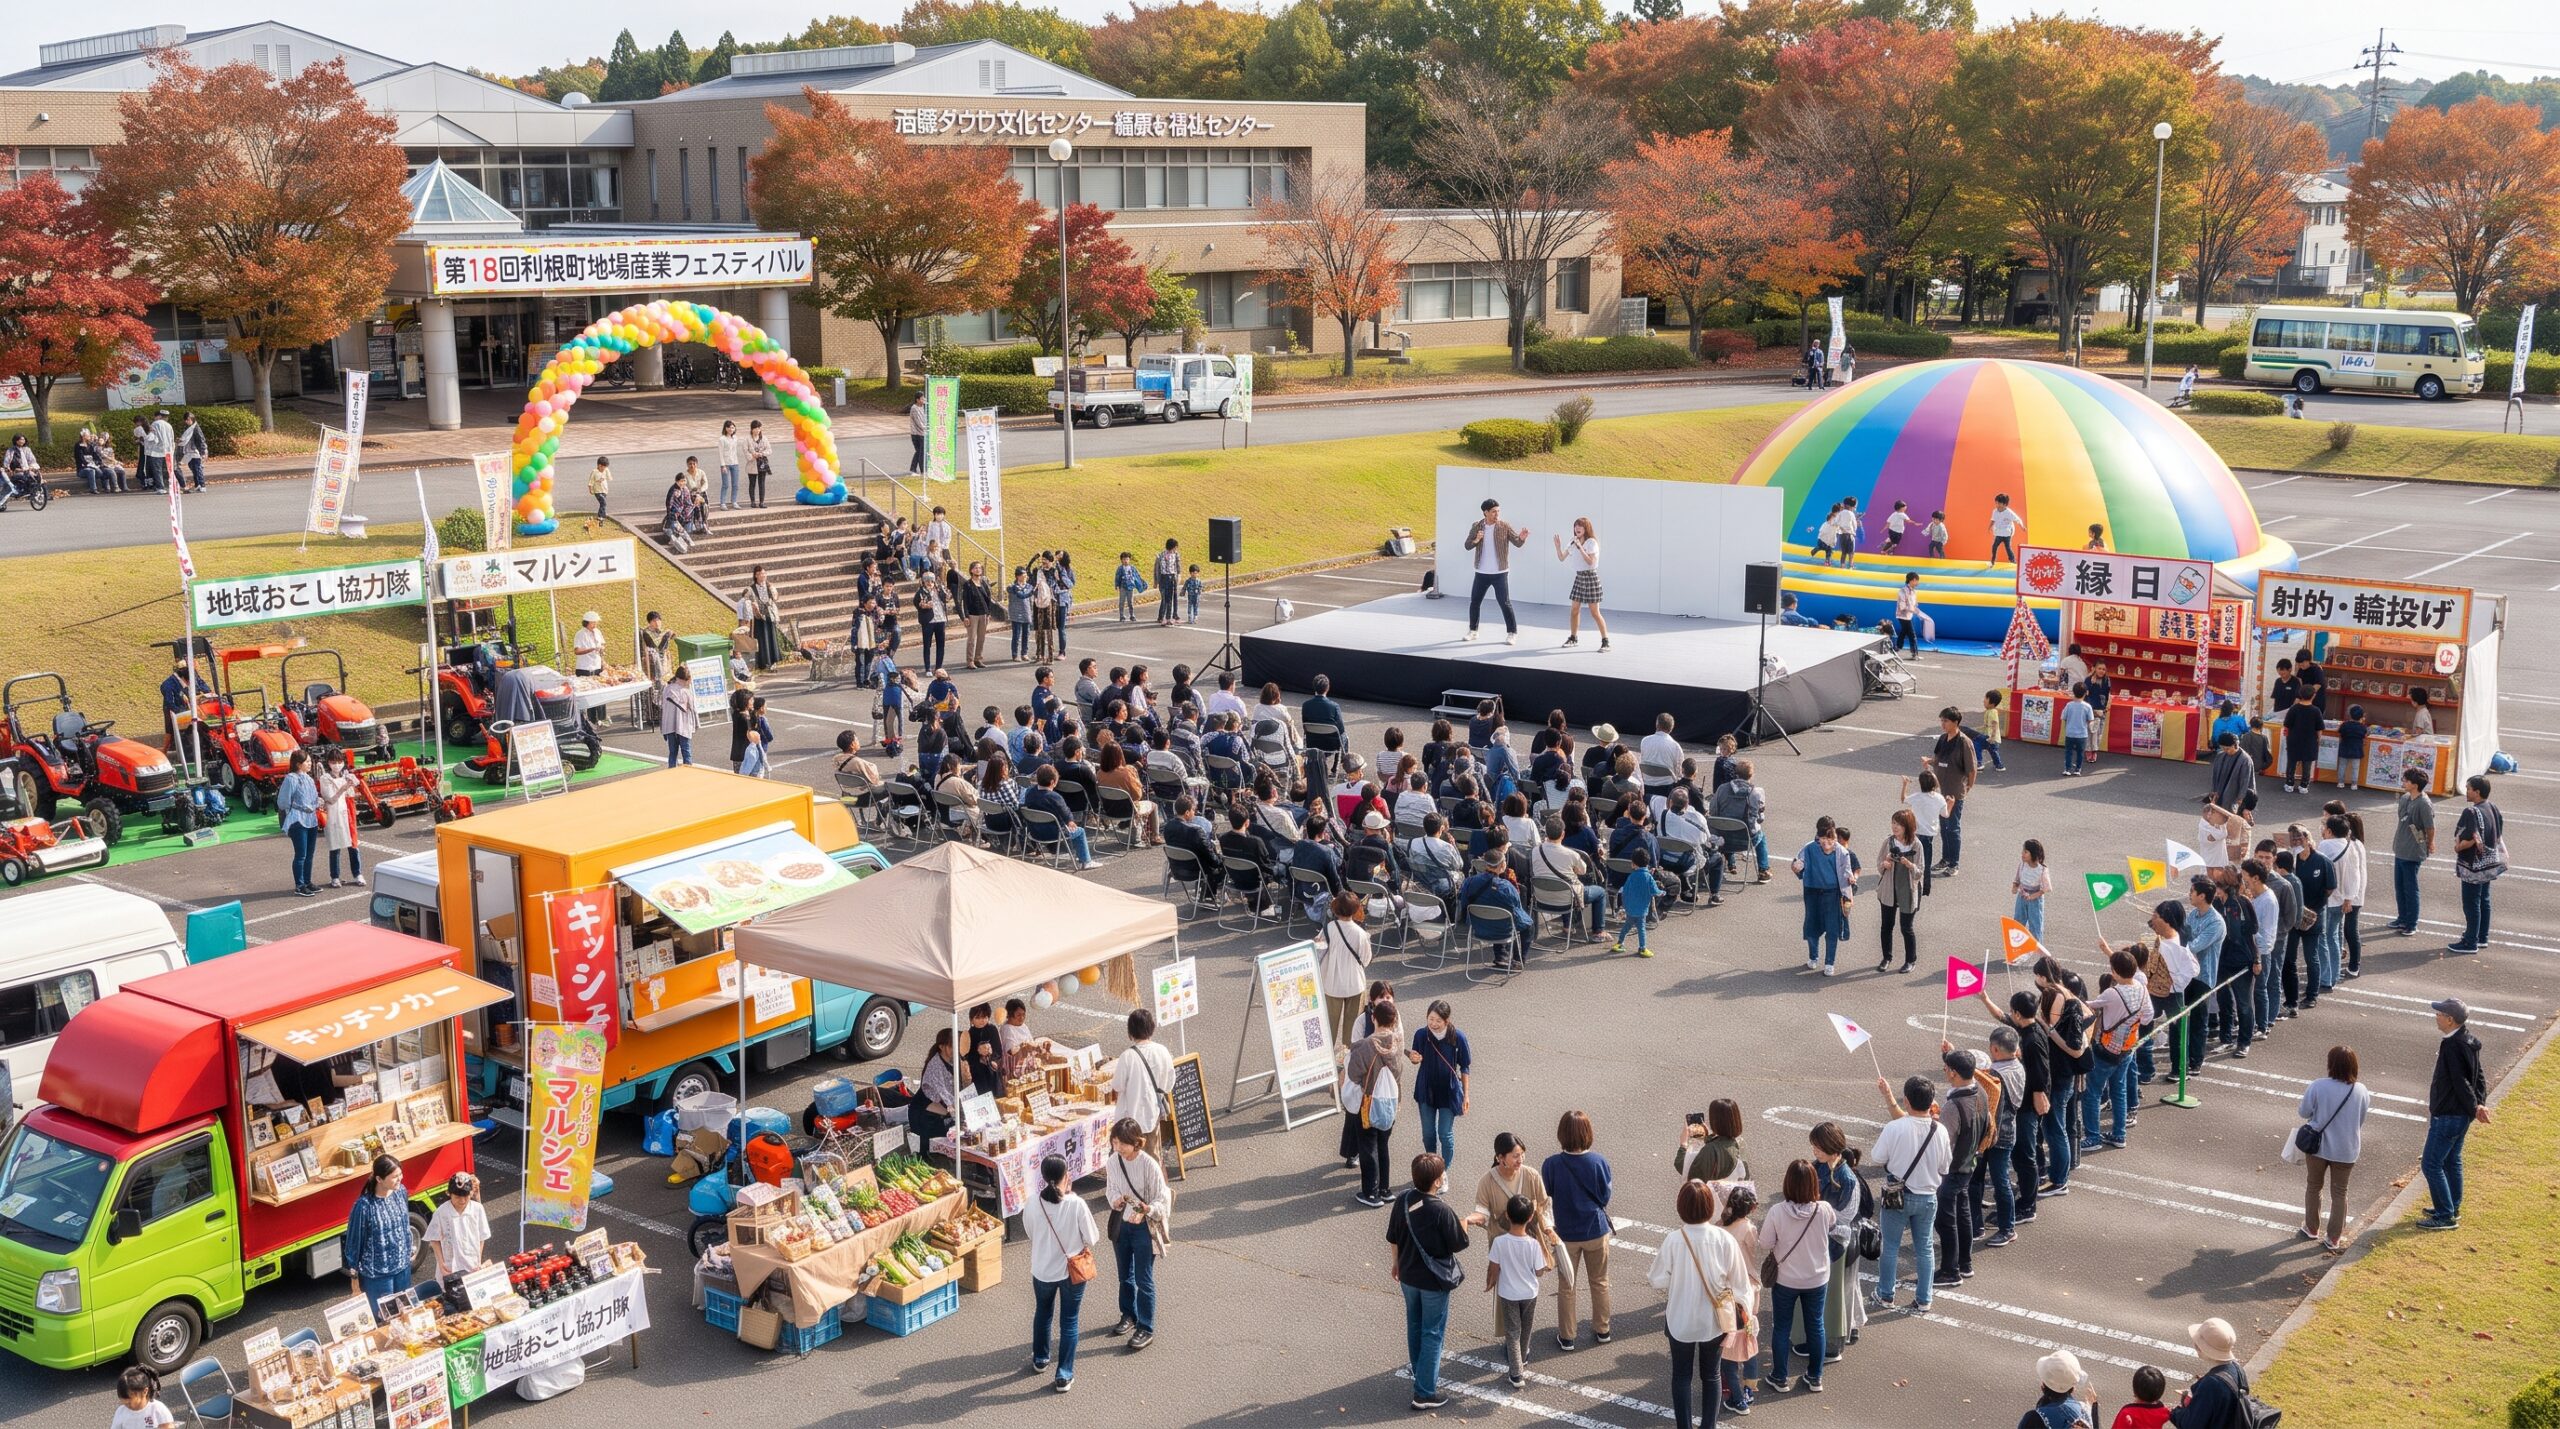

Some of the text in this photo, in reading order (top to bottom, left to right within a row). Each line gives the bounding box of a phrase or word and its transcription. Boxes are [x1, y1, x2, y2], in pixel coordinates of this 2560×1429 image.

[443, 250, 804, 284] 第18回利根町地場産業フェスティバル
[514, 551, 617, 584] マルシェ
[206, 570, 411, 617] 地域おこし協力隊
[2271, 586, 2455, 630] 射的・輪投げ
[285, 985, 460, 1045] キッチンカー
[542, 1079, 577, 1191] マルシェ
